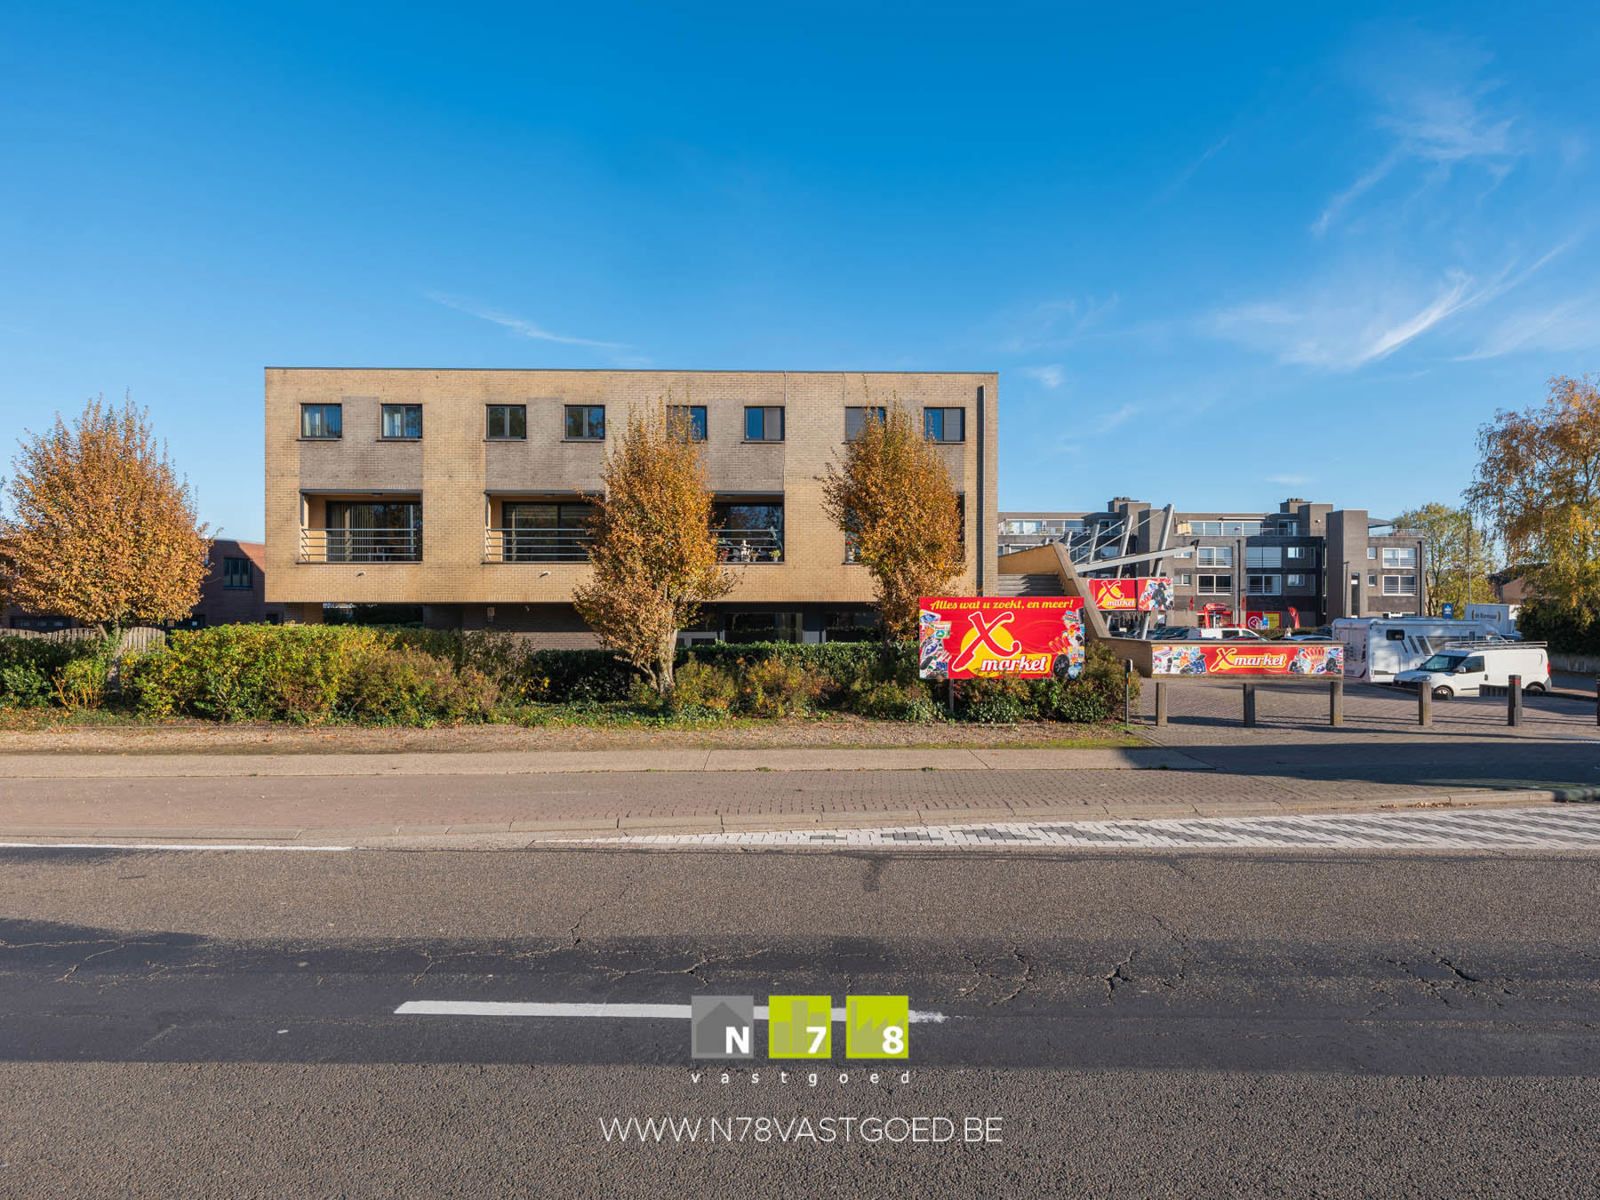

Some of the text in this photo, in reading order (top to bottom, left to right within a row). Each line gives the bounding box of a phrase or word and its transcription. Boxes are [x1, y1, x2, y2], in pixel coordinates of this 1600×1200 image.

[930, 600, 957, 610] Alles
[959, 601, 981, 610] wat
[1041, 599, 1074, 609] meer!
[952, 611, 1022, 672] X
[981, 655, 1047, 672] market
